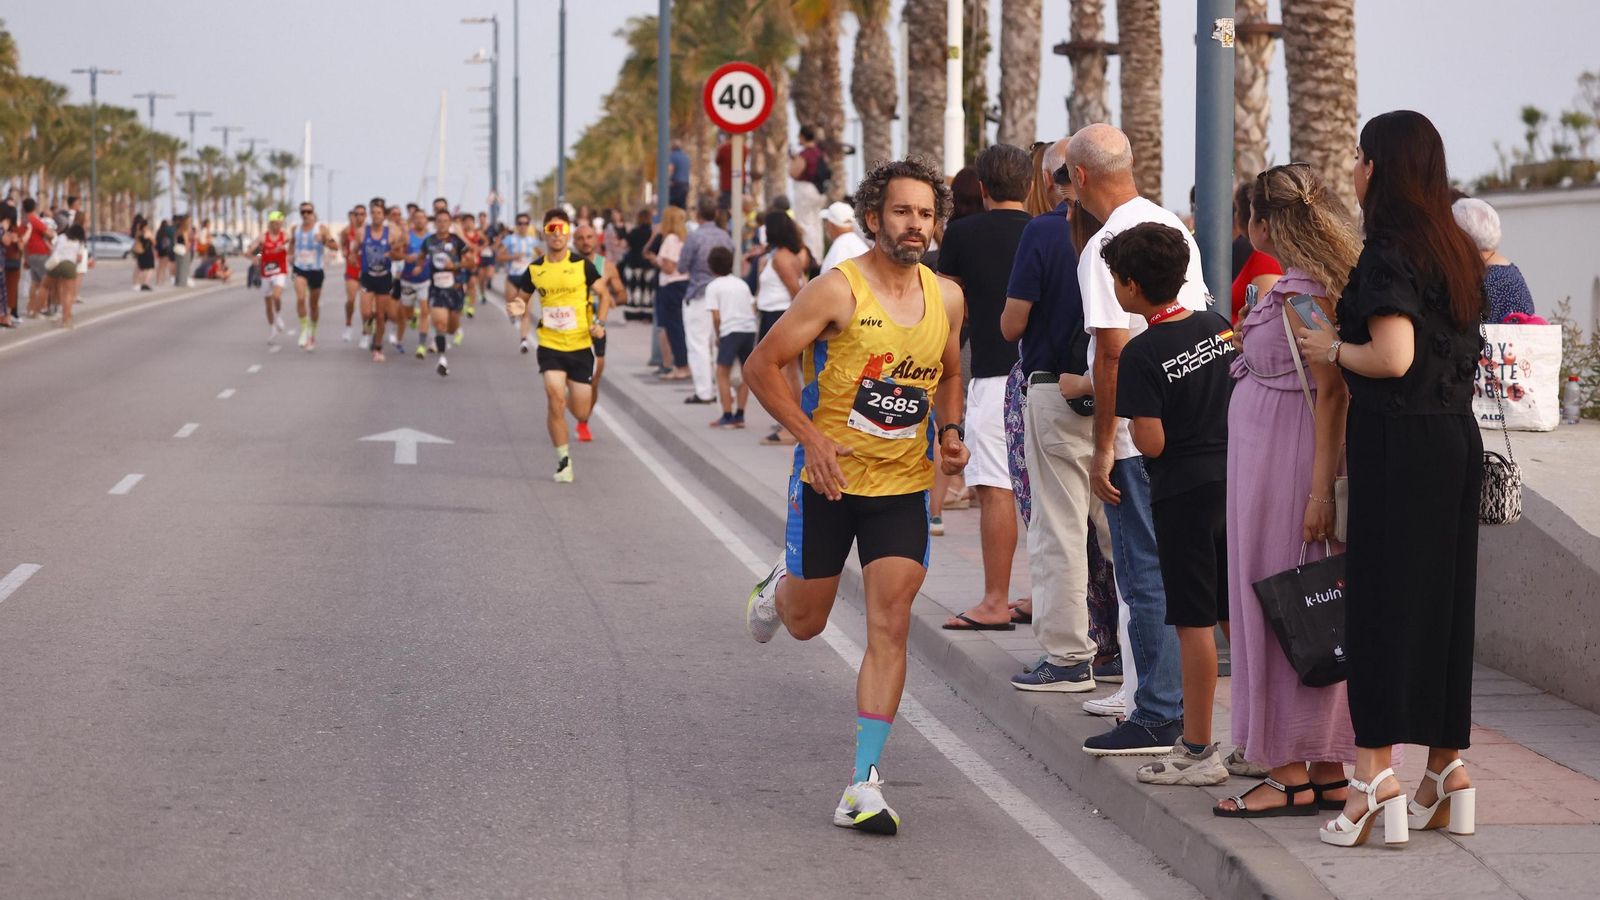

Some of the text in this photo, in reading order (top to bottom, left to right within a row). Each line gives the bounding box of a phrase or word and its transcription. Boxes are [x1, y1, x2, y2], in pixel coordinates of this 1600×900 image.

[719, 84, 755, 109] 40
[860, 316, 883, 327] vive
[1162, 334, 1224, 373] POLICIA
[867, 392, 919, 414] 2685
[1304, 588, 1342, 608] k-tuin
